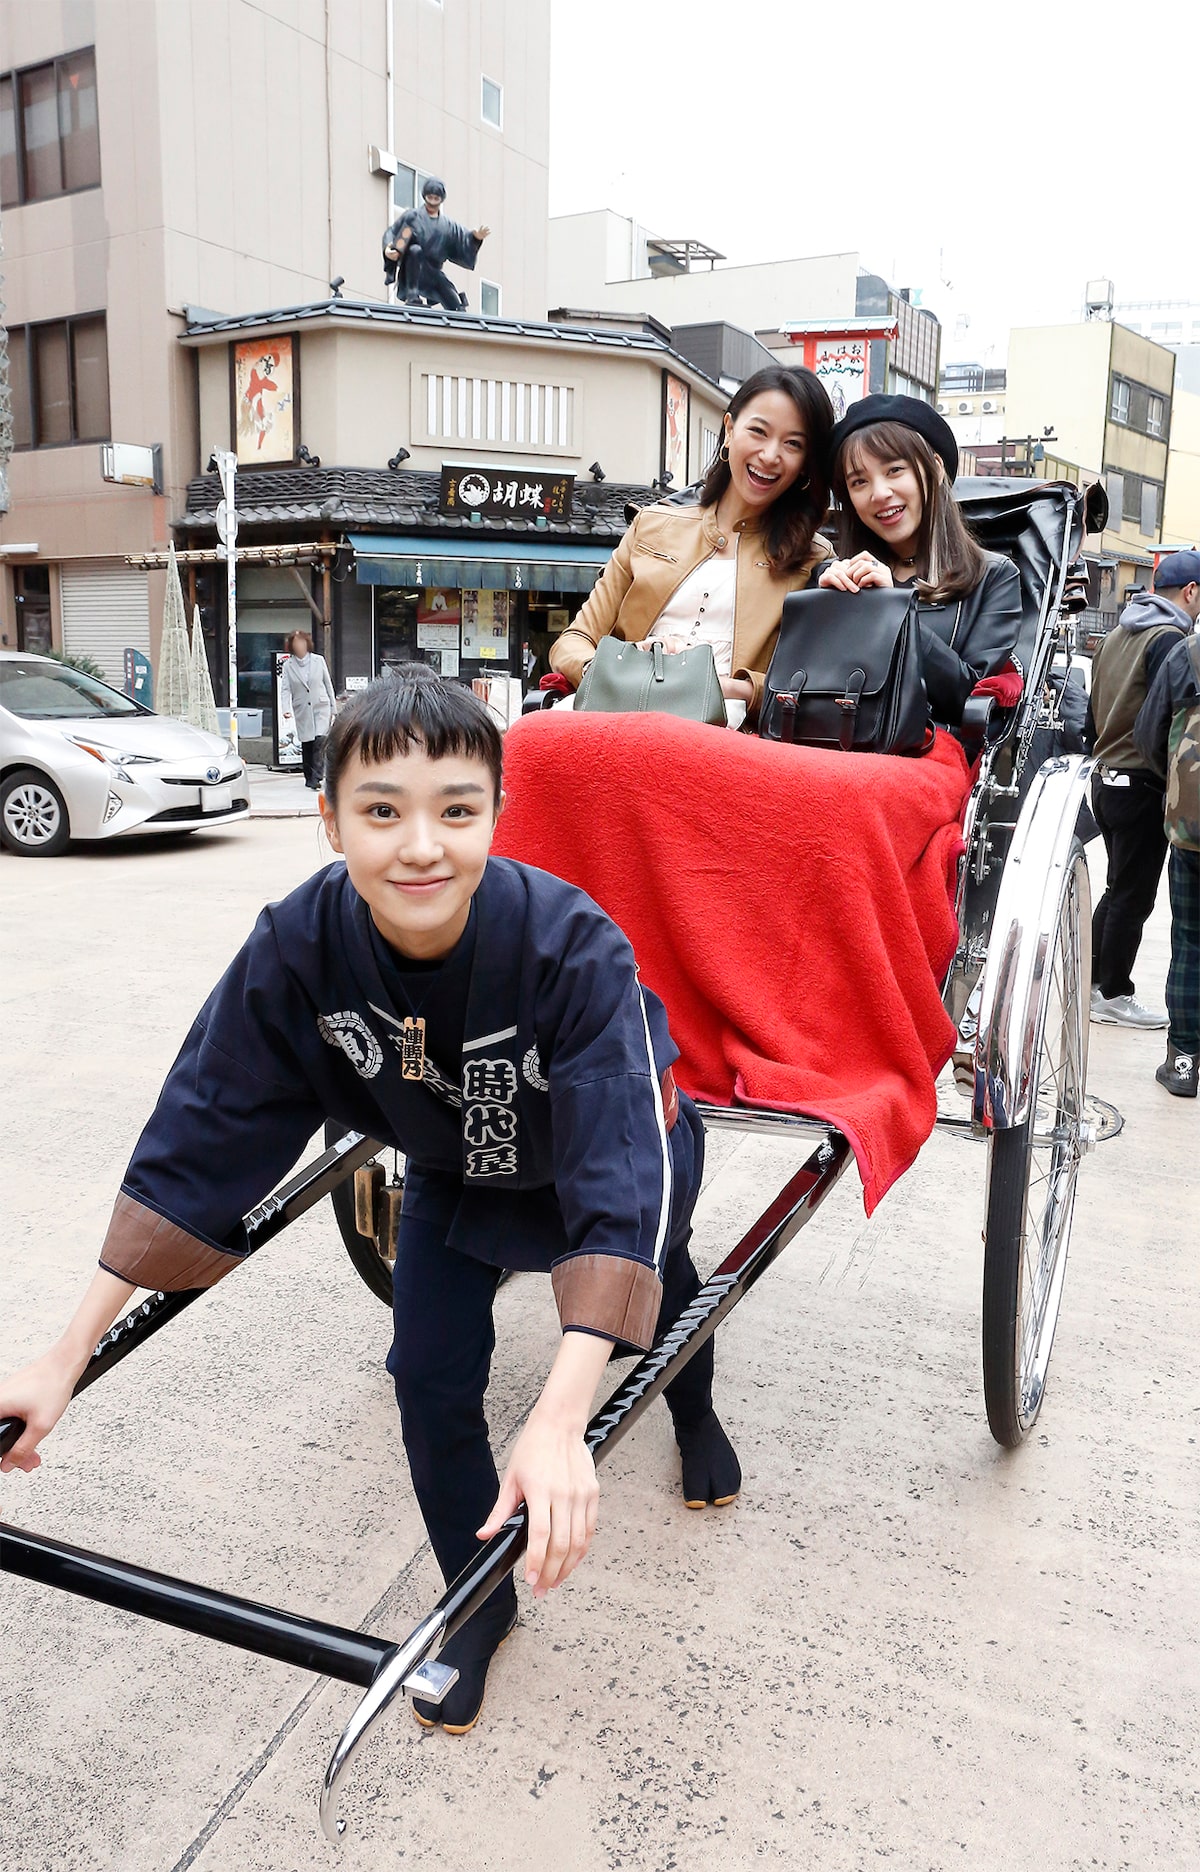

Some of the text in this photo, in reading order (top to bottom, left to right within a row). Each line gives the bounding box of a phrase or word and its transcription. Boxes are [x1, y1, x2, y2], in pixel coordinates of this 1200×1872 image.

[493, 481, 545, 508] 胡蝶
[463, 1058, 519, 1177] 時代屋
